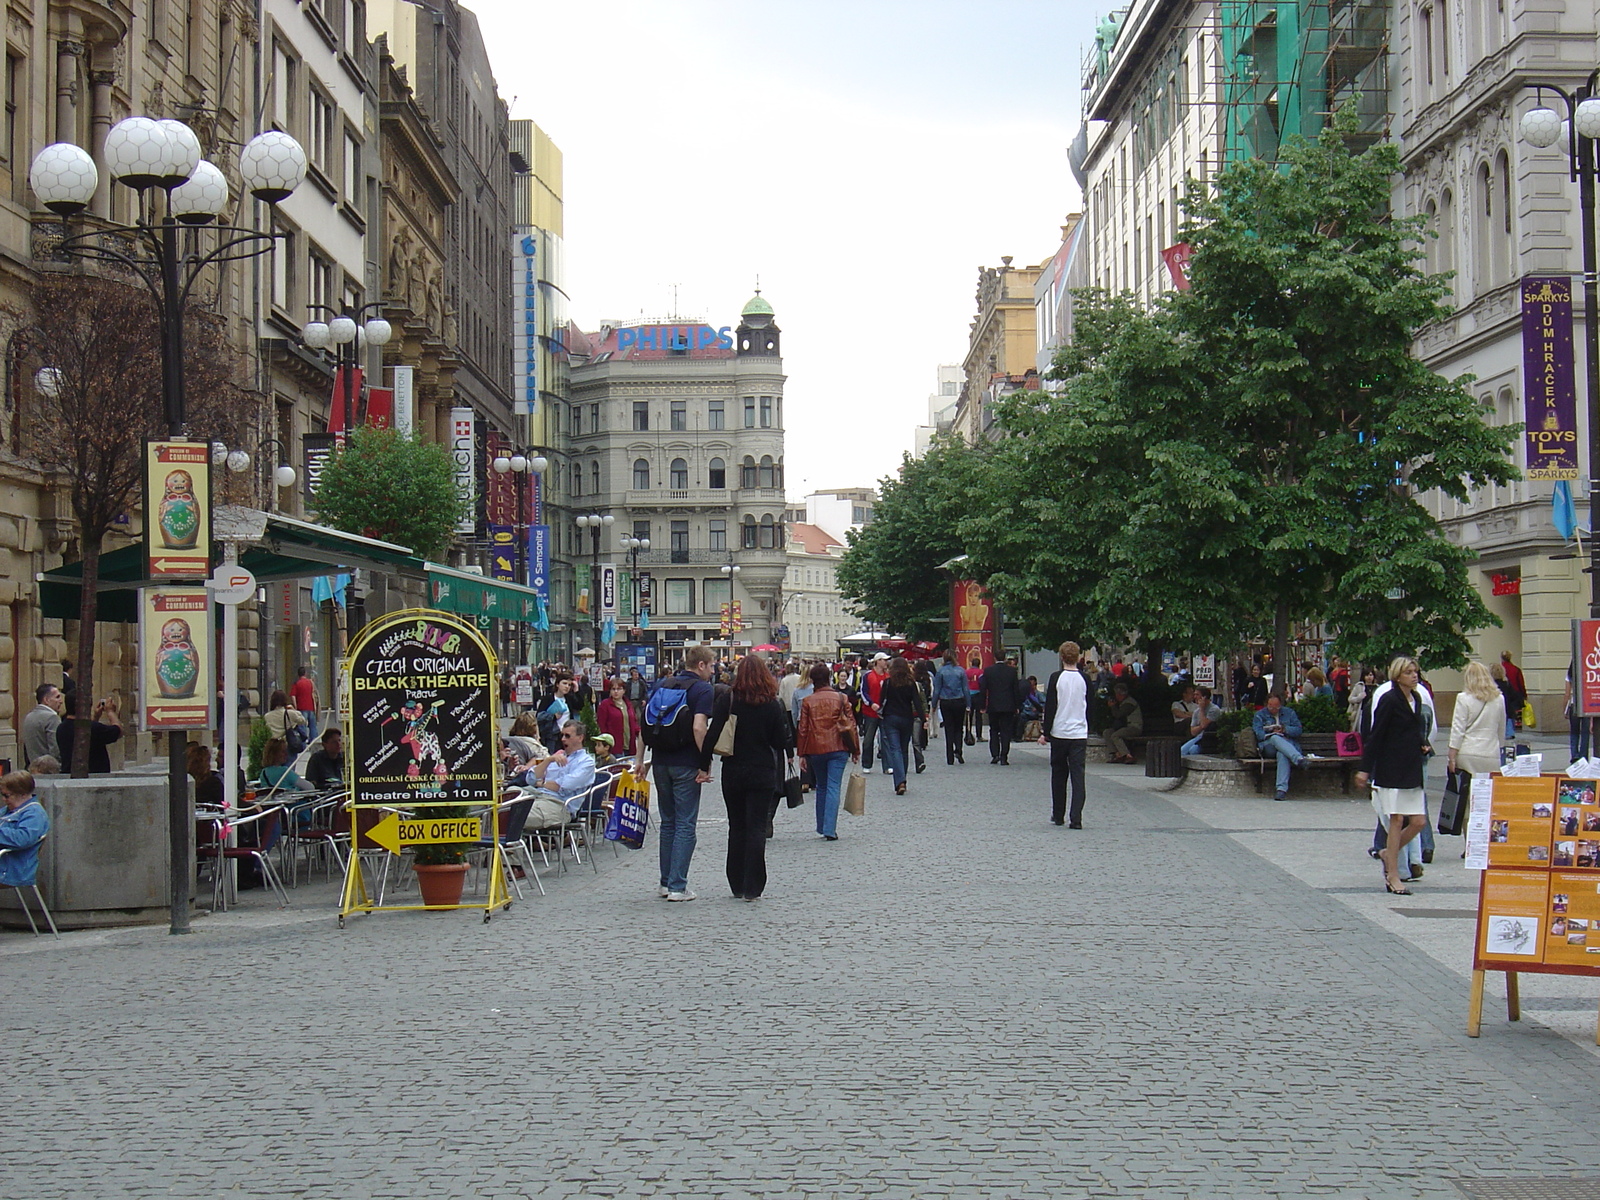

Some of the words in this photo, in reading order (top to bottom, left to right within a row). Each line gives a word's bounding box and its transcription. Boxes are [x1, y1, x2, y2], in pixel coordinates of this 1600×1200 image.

[1524, 293, 1570, 303] SPARKYS
[1542, 304, 1554, 337] DŮM
[526, 258, 535, 414] TECHNOEXPORT
[617, 326, 733, 350] PHILIPS
[1544, 342, 1556, 408] HRAČEK
[1528, 431, 1576, 442] TOYS
[1530, 470, 1578, 479] SPARKYS
[535, 530, 543, 574] Samsonite
[166, 602, 204, 610] COMMUNISM
[366, 657, 406, 676] CZECH
[413, 657, 474, 674] ORIGINAL
[355, 676, 408, 690] BLACK
[416, 674, 488, 688] THEATRE
[362, 705, 378, 719] every
[377, 698, 387, 709] day
[367, 712, 380, 723] 8:30
[364, 756, 375, 767] non
[367, 745, 399, 774] performance
[359, 775, 403, 783] ORIGINÁLNÍ
[404, 774, 428, 782] ČESKÉ
[429, 773, 454, 781] ČERNÉ
[361, 791, 411, 801] theatre
[415, 790, 447, 799] here
[453, 789, 469, 798] 10
[622, 802, 647, 825] CENU
[398, 824, 424, 840] BOX
[431, 822, 477, 838] OFFICE
